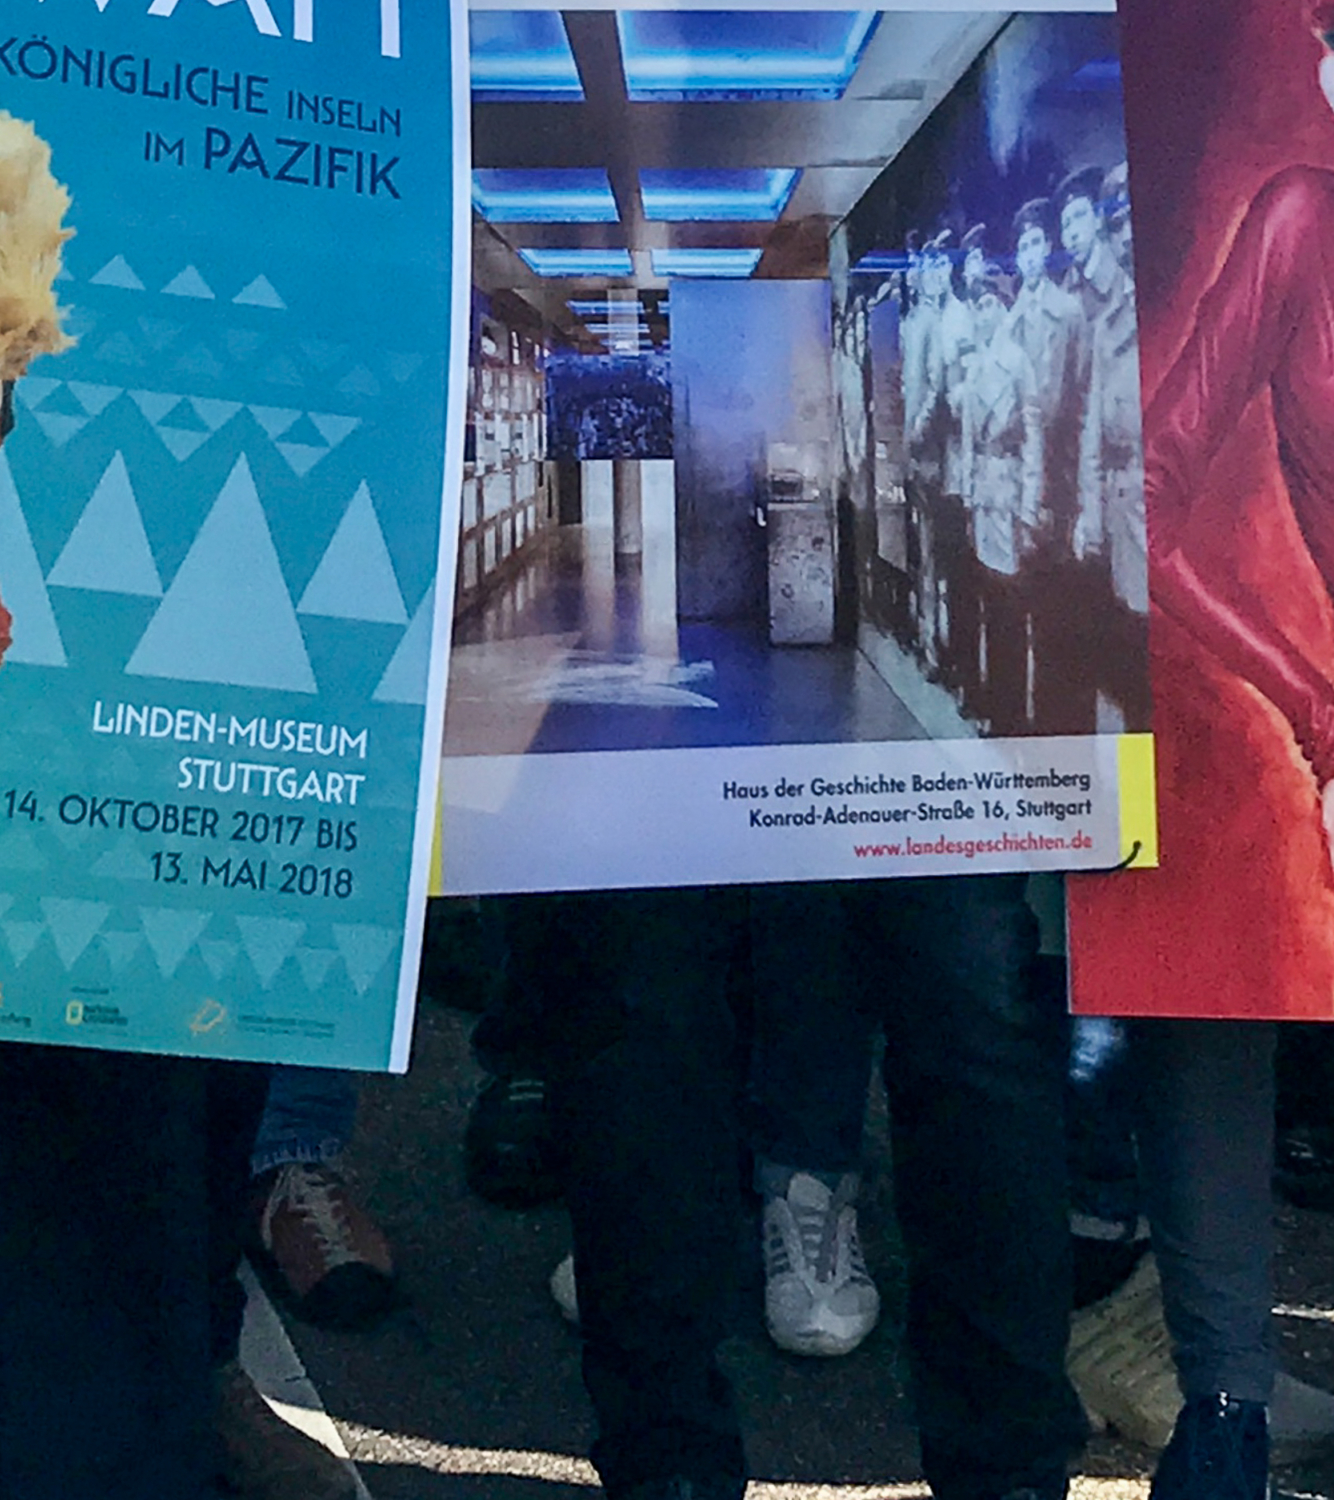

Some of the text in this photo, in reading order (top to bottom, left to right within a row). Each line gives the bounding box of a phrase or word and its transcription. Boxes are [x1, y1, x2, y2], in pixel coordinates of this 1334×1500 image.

[287, 90, 403, 138] INSELN
[144, 126, 401, 200] IM PAZIFIK
[93, 700, 368, 759] LINDEN-MUSEUM
[177, 757, 366, 805] STUTTGART
[723, 767, 1091, 800] Haus der Geschichte Baden-Württemberg
[4, 789, 358, 852] 14. OKTOBER 2017 BIS
[749, 798, 1093, 828] Konrad-Adenauer-Straße 16, Stuttgart
[854, 831, 1093, 859] www.landesgeschichten.de
[151, 851, 353, 899] 13. MAI 2018
